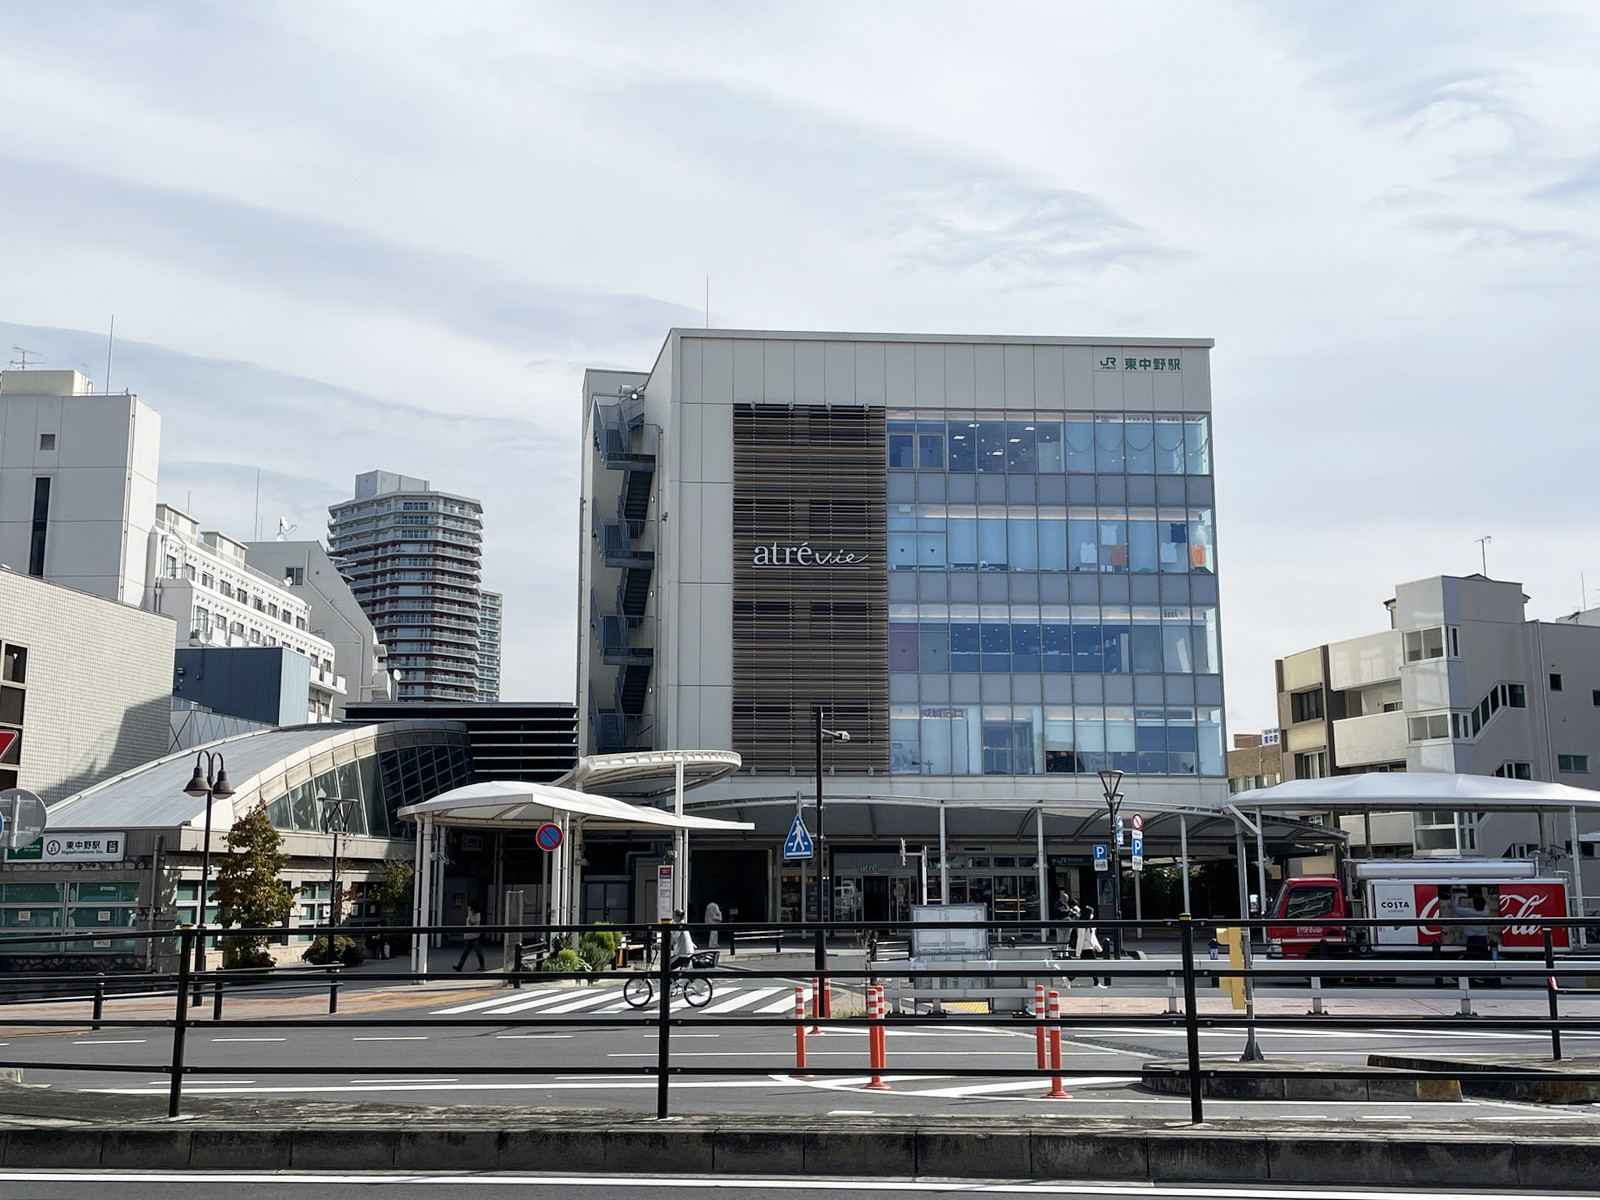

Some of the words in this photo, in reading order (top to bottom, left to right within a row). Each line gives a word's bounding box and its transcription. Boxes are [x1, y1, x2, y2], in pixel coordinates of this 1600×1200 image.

[1100, 357, 1116, 366] JR
[1124, 357, 1180, 371] 東中野駅
[753, 541, 813, 566] atré
[815, 548, 869, 565] vie
[65, 840, 101, 850] 東中野駅
[1134, 840, 1141, 854] P
[1096, 846, 1104, 858] P
[1381, 901, 1410, 909] COSTA
